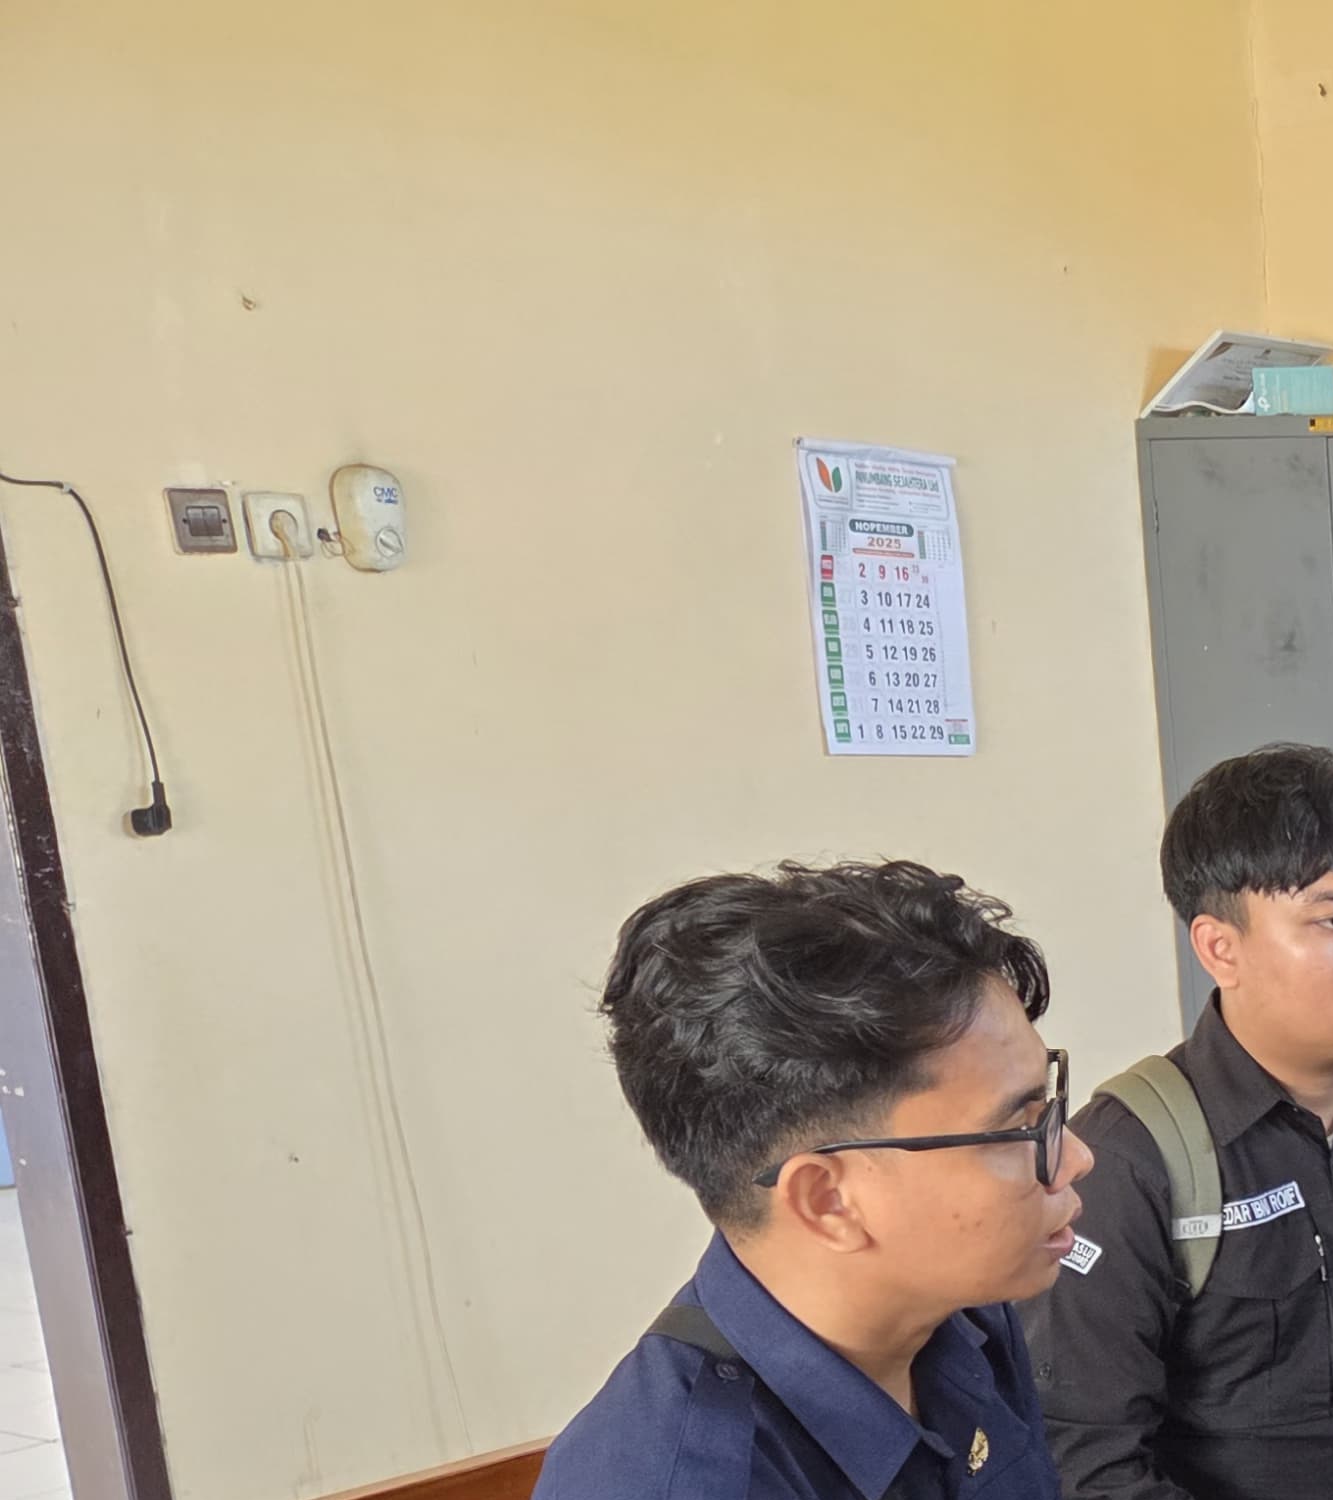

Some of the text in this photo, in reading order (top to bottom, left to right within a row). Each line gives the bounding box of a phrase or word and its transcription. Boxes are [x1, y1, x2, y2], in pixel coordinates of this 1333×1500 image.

[855, 521, 909, 535] NOPEMBER
[867, 536, 901, 549] 2025
[858, 563, 866, 578] 2
[878, 565, 886, 580] 9
[895, 566, 909, 581] 16
[861, 590, 930, 609] 3 10 17 24
[863, 617, 934, 635] 4 11 18 25
[866, 644, 937, 662] 5 12 19 26
[868, 671, 937, 688] 6 13 20 27
[872, 698, 940, 714] 7 14 21 28
[858, 724, 944, 740] 1 8 15 22 29
